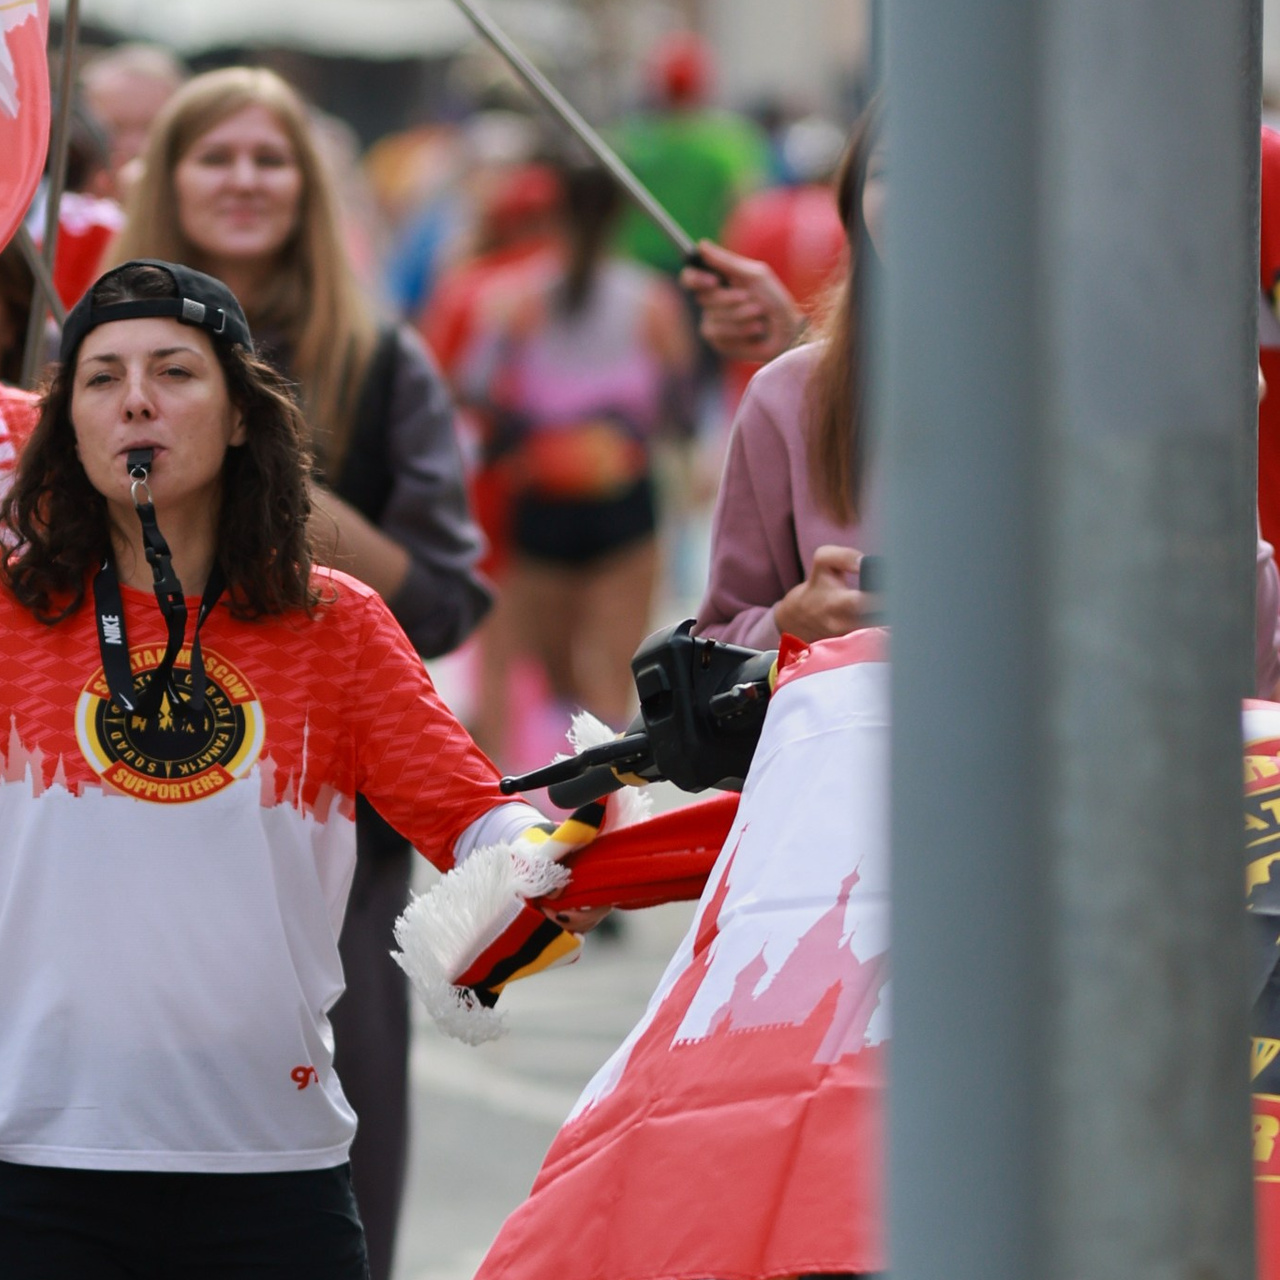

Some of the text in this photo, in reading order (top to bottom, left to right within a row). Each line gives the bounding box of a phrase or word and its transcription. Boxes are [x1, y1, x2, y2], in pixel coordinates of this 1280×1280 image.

[102, 615, 122, 644] NIKE
[178, 648, 249, 699] MSCOW
[184, 674, 231, 717] СВАД
[110, 731, 157, 773] SQUAD
[112, 769, 224, 799] SUPPORTERS
